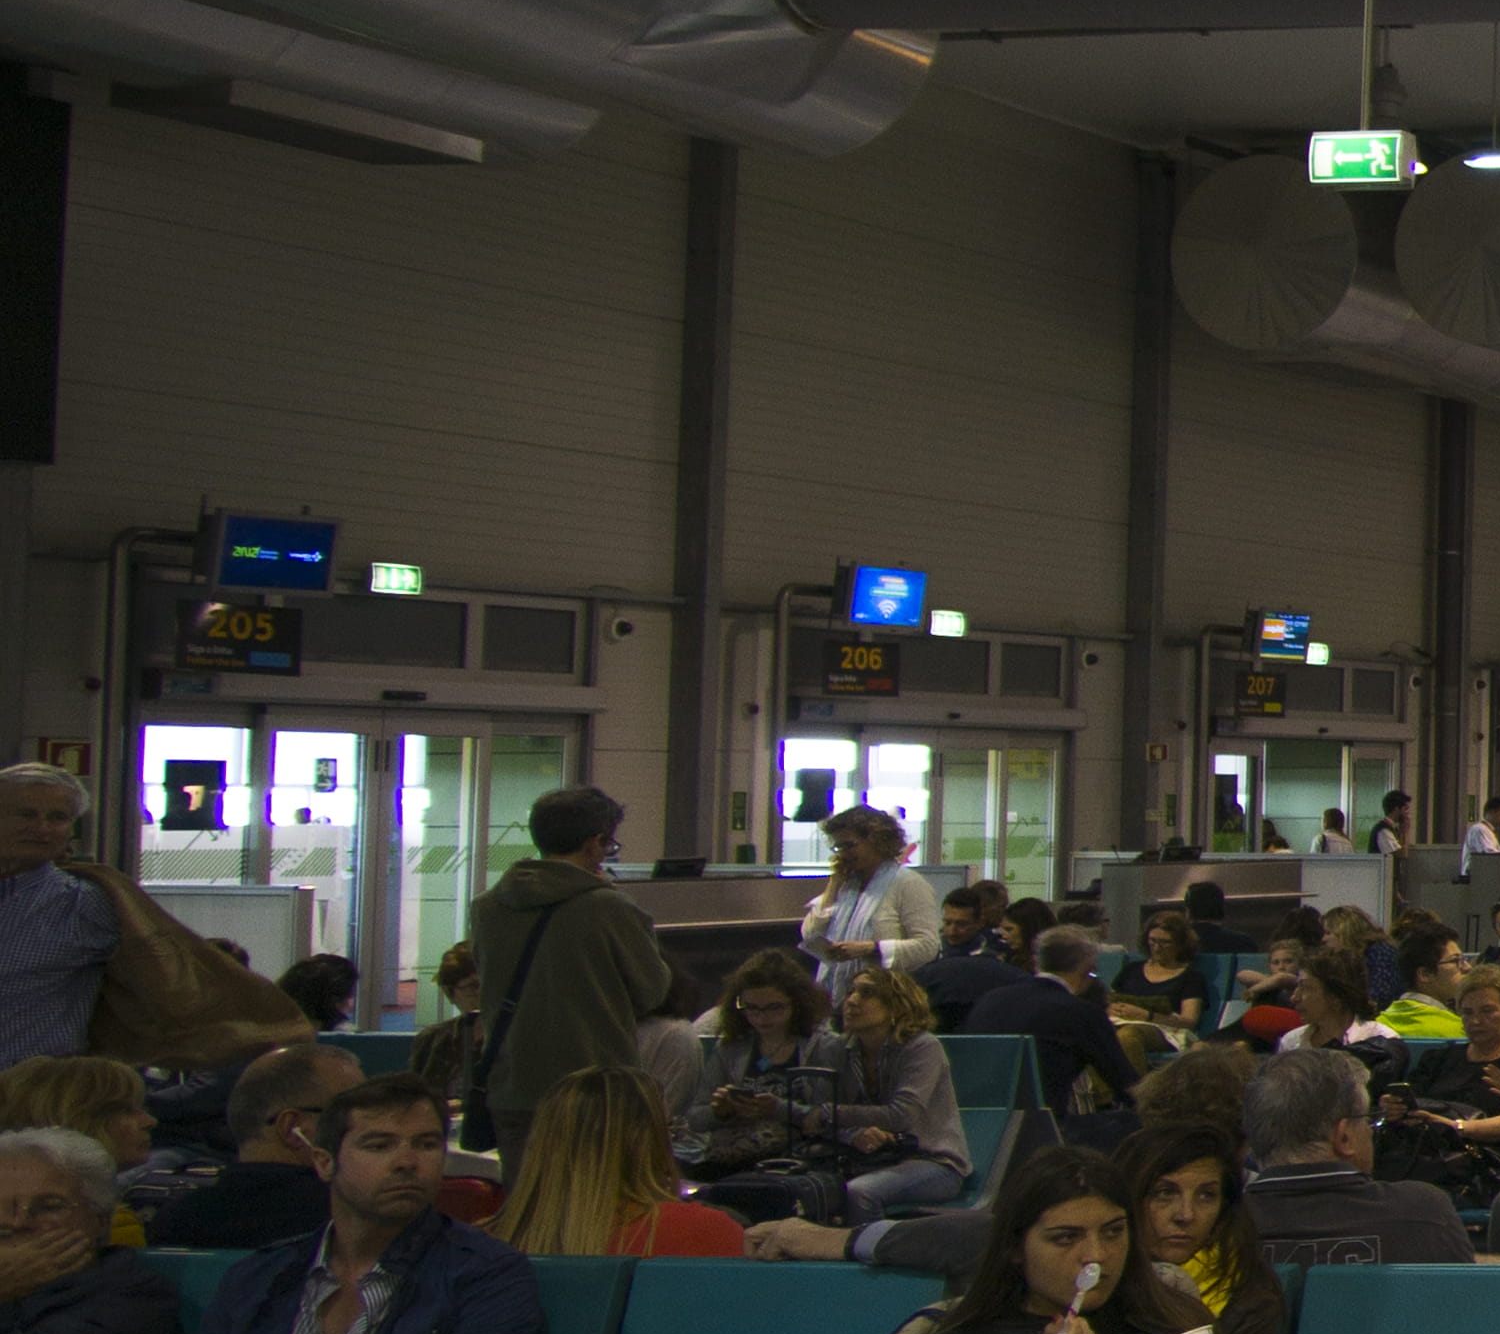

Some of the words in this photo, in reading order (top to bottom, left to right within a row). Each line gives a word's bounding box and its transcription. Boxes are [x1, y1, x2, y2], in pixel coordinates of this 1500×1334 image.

[207, 609, 275, 642] 205
[840, 646, 883, 671] 206
[1247, 675, 1276, 696] 207
